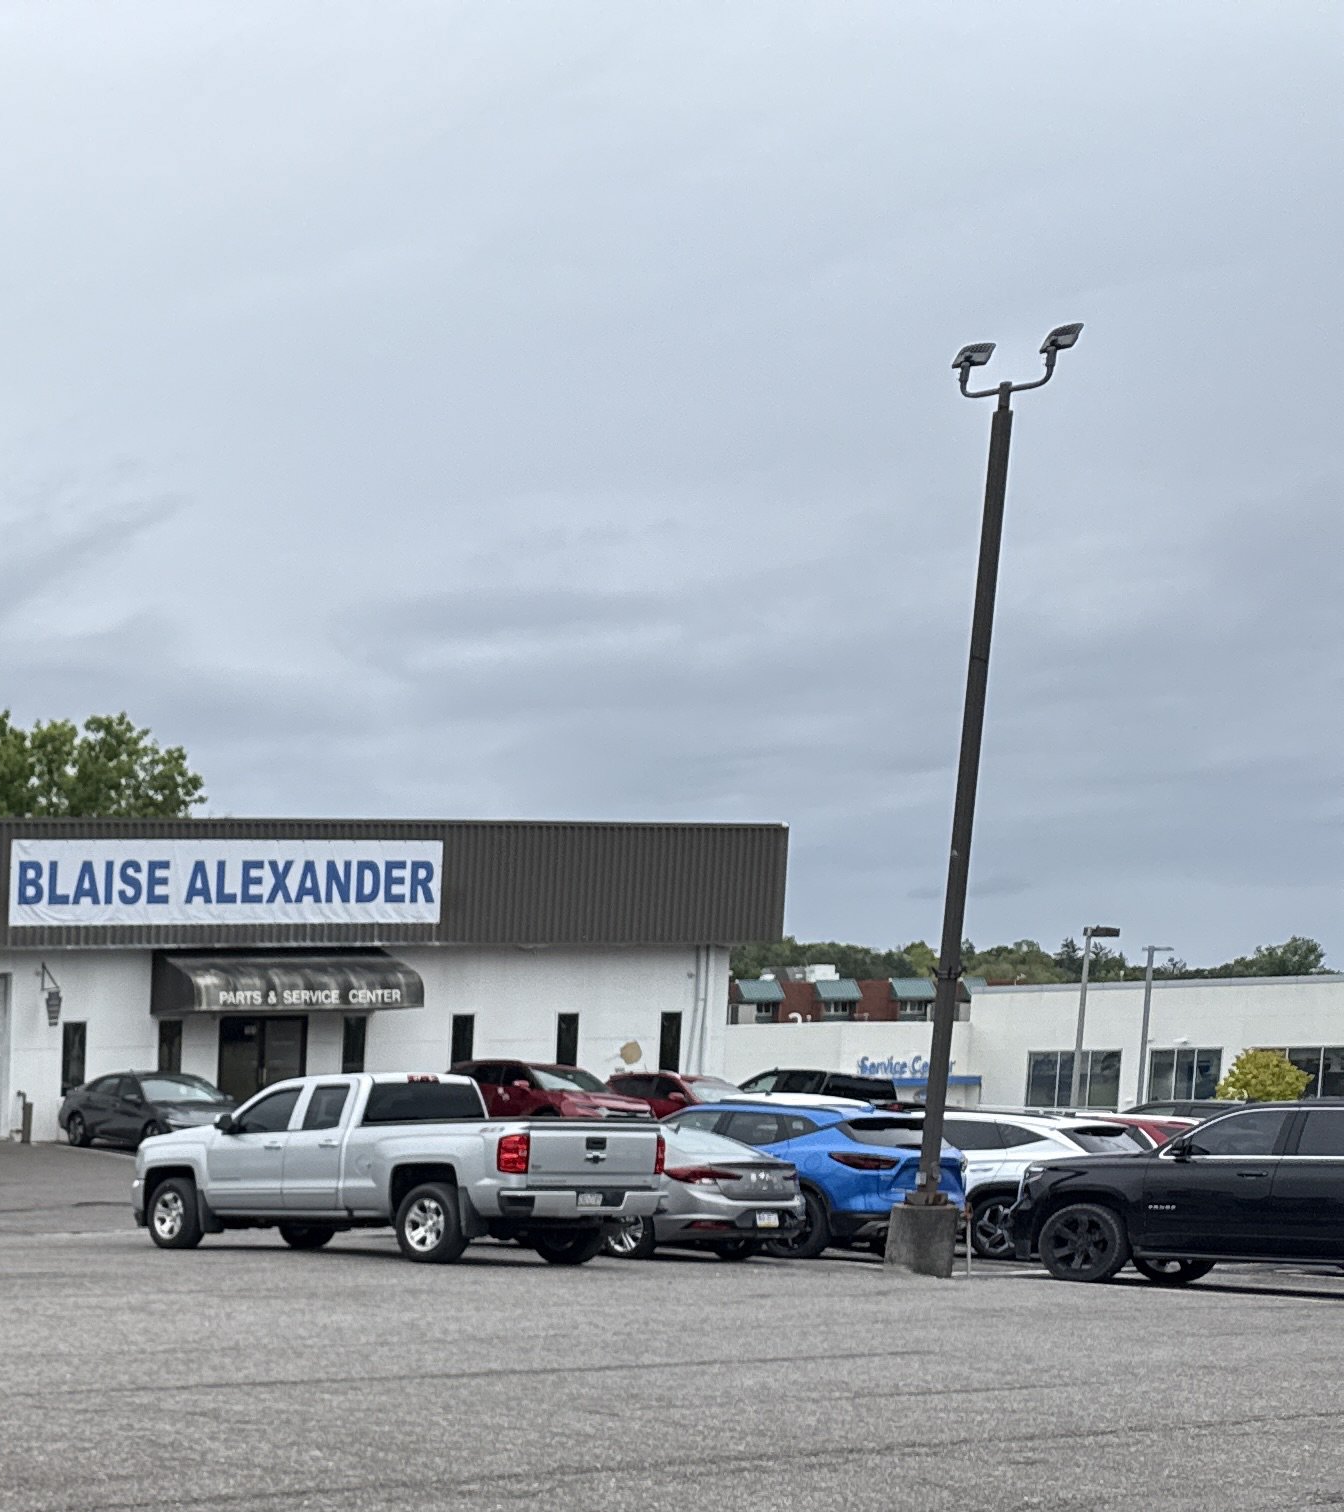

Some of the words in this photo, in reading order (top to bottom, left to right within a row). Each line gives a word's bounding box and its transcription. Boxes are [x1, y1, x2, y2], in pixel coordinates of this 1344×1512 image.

[17, 860, 171, 906] BLAISE
[184, 859, 435, 905] ALEXANDER
[219, 990, 262, 1005] PARTS
[268, 990, 277, 1004] &
[283, 989, 340, 1005] SERVICE
[348, 988, 402, 1004] CENTER
[858, 1056, 908, 1075] Service
